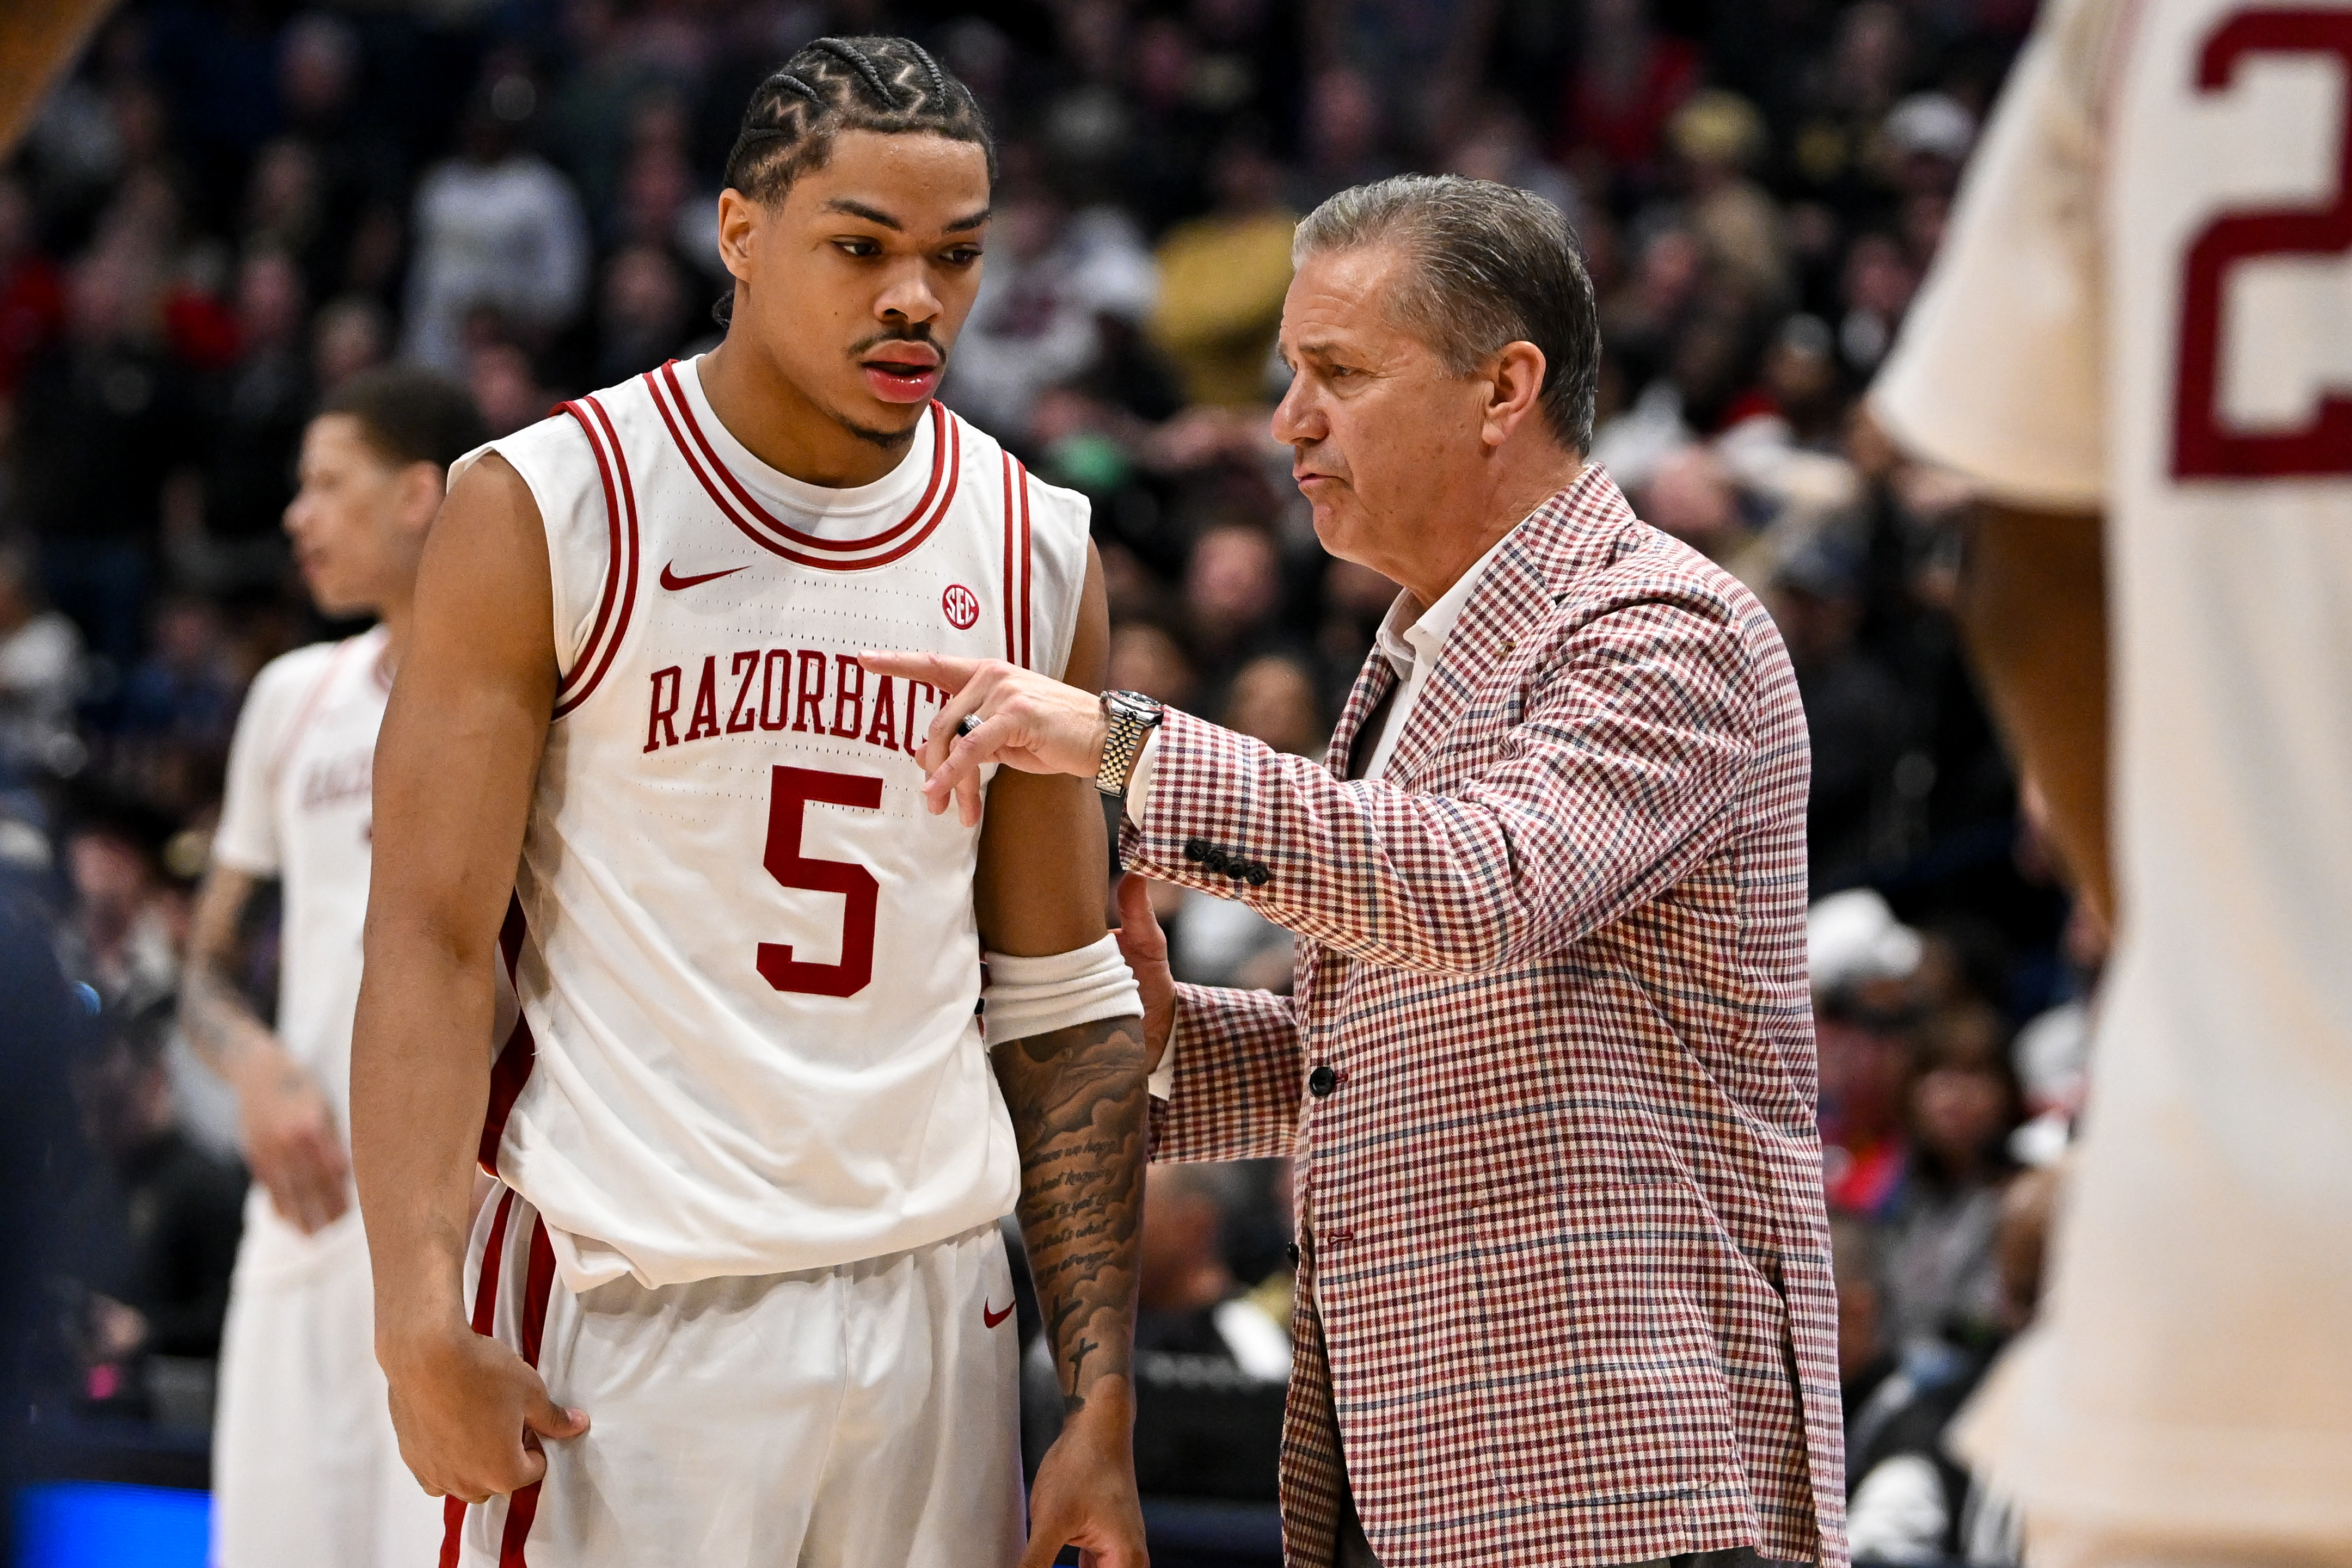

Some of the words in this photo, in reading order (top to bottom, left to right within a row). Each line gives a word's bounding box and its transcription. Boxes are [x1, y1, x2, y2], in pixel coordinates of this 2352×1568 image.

[2173, 11, 2352, 479] 2
[945, 587, 975, 625] SEC
[643, 649, 950, 757] RAZORBAC
[757, 765, 883, 997] 5
